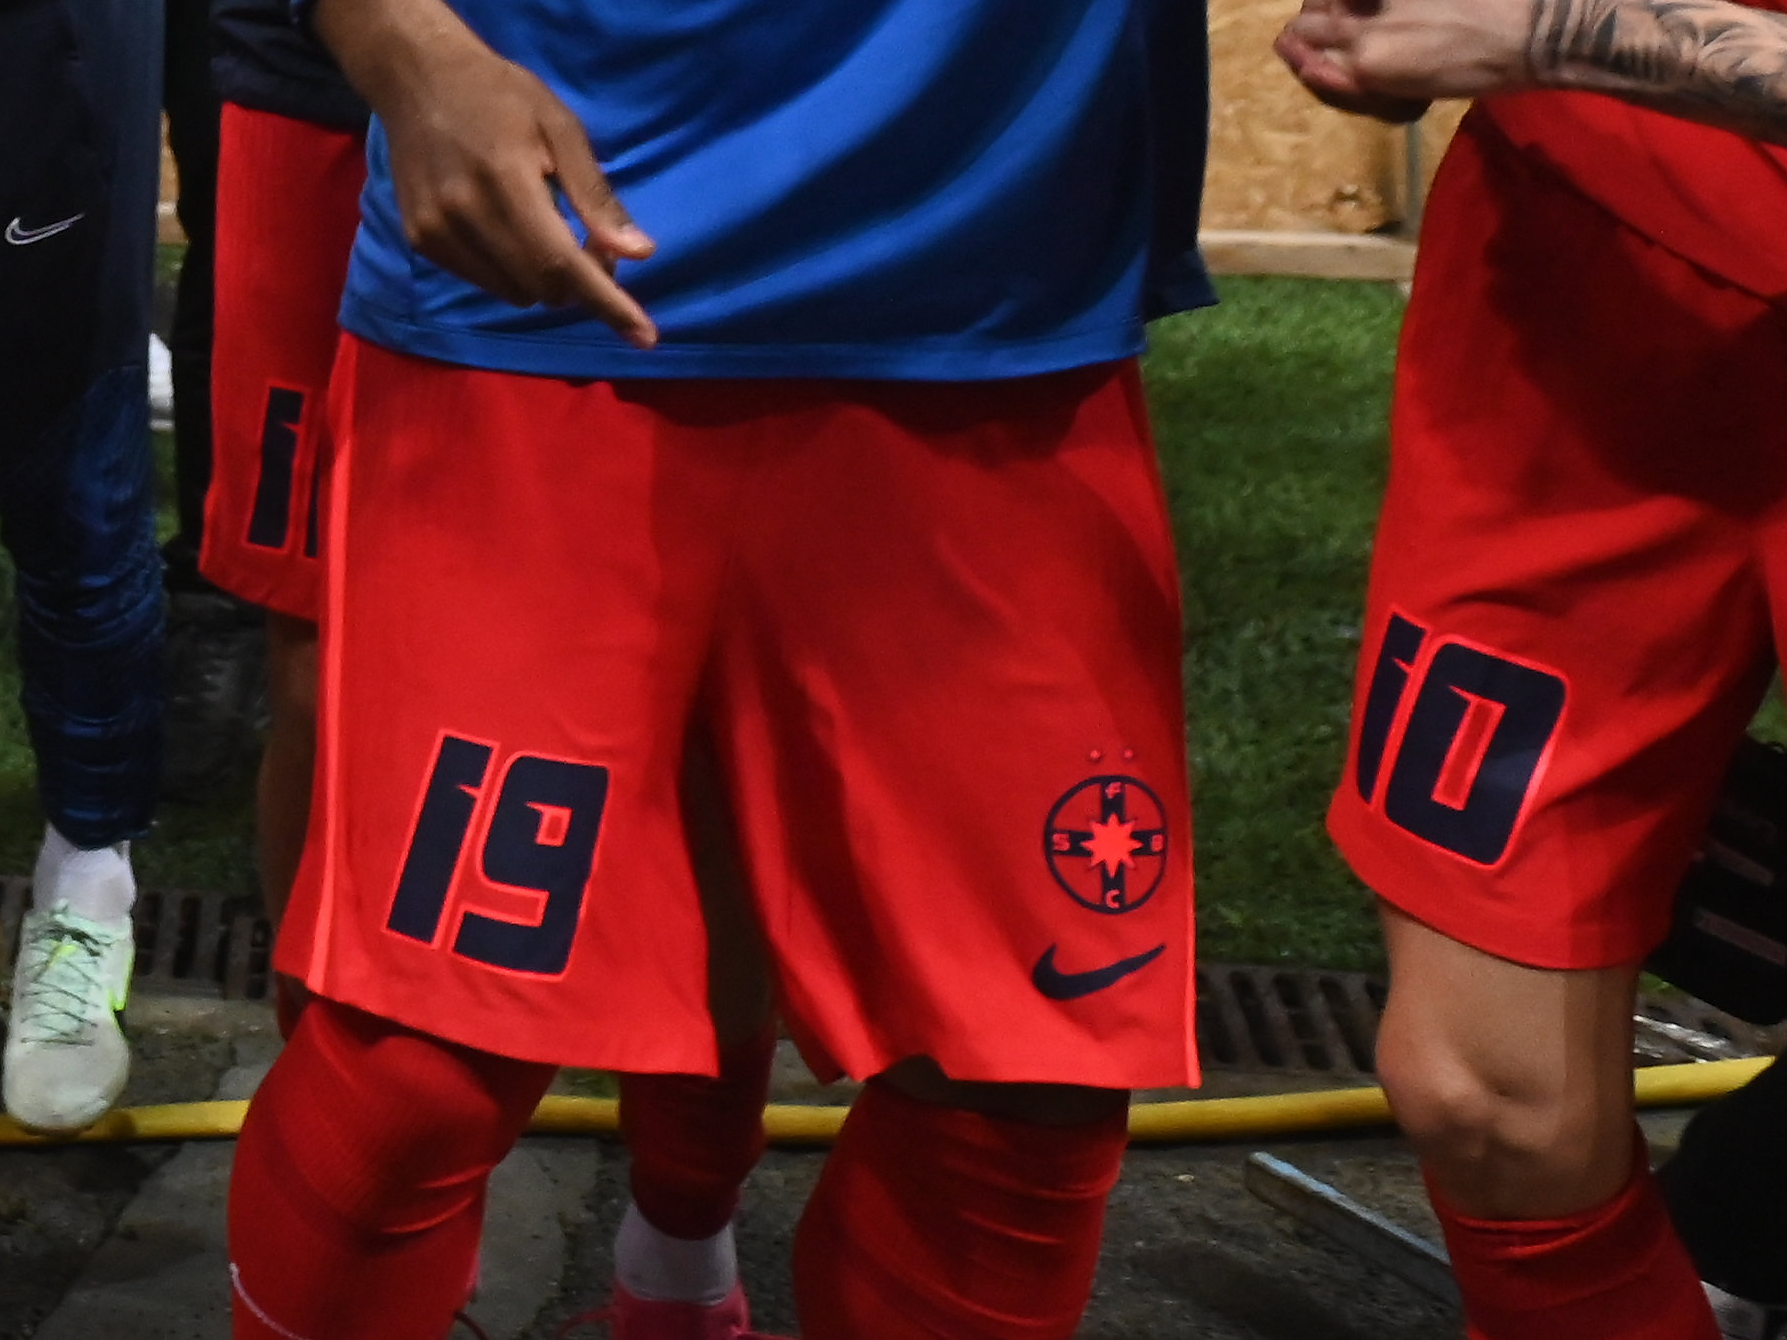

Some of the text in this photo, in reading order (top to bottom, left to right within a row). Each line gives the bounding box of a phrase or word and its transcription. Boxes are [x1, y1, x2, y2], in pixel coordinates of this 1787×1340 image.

[247, 385, 319, 559] 1
[387, 735, 610, 976] 19
[1356, 611, 1567, 867] 10
